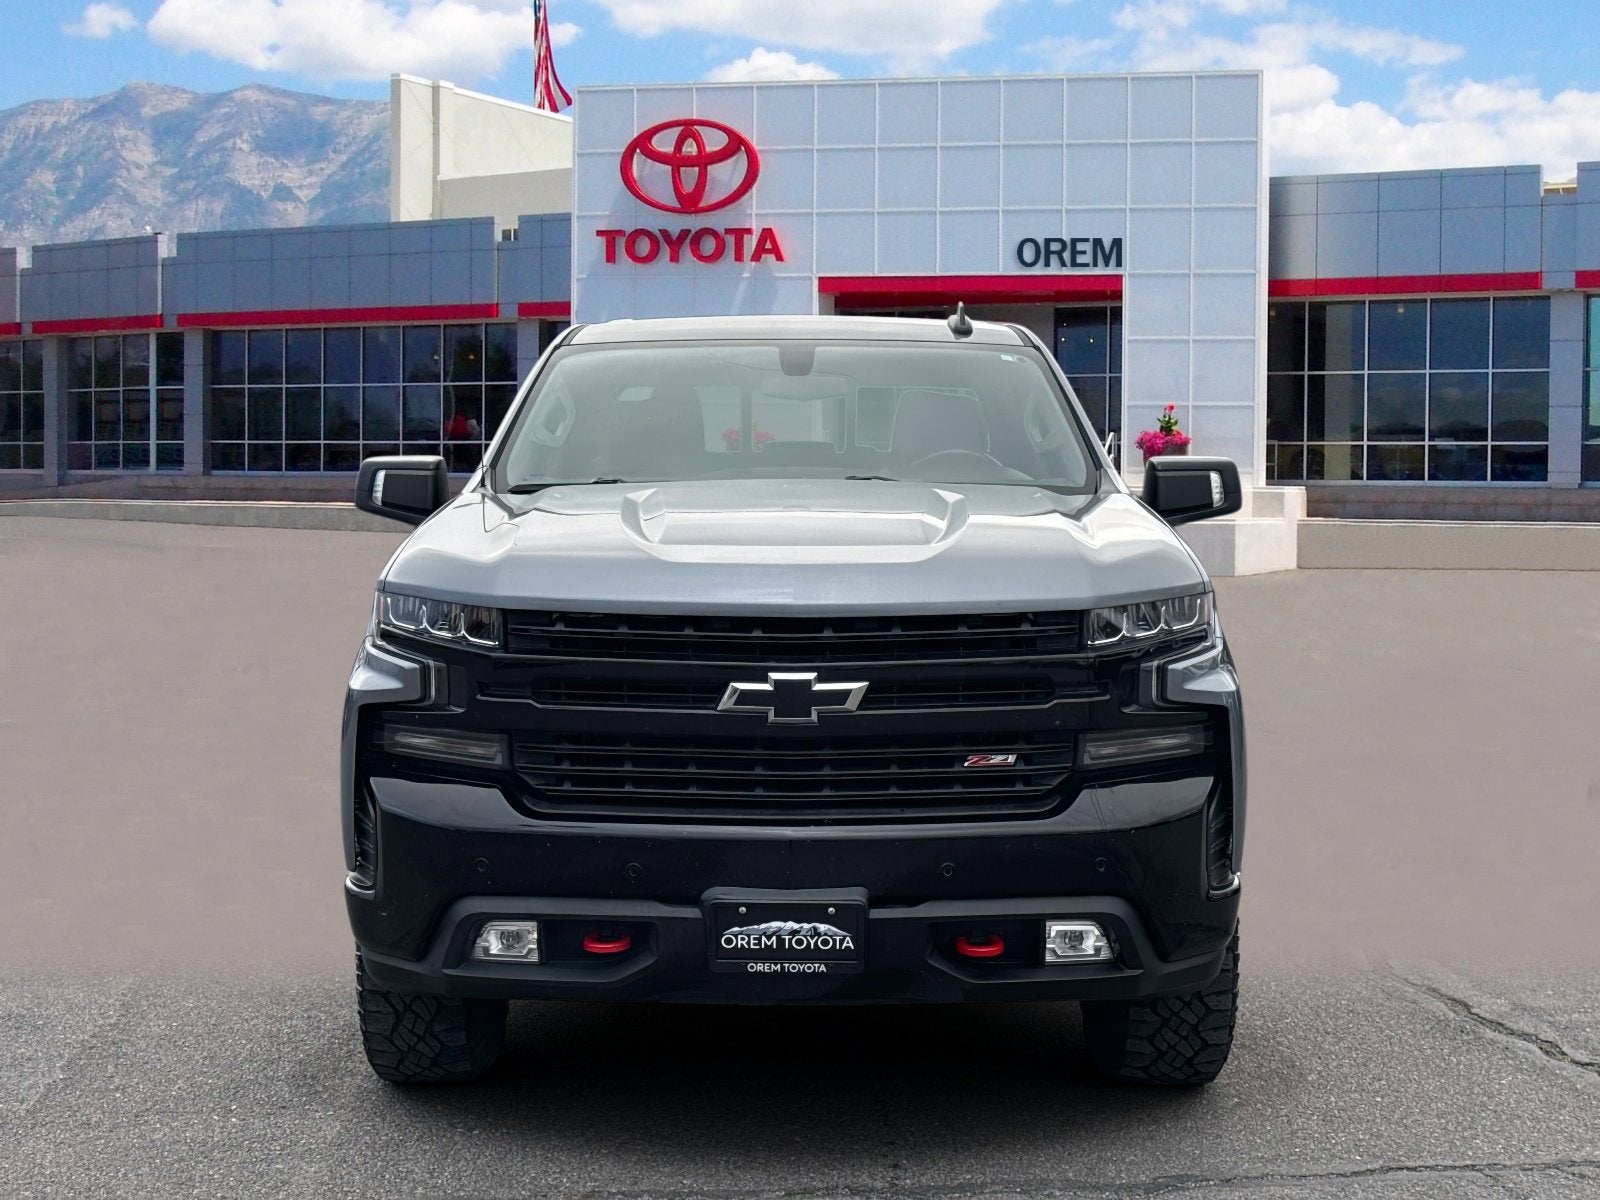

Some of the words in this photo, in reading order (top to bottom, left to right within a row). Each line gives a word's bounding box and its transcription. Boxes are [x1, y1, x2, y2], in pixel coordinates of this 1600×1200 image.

[596, 227, 785, 264] TOYOTA
[1016, 237, 1123, 268] OREM
[963, 753, 1018, 768] Z71
[721, 934, 777, 949] OREM
[781, 935, 855, 950] TOYOTA
[747, 963, 781, 973] OREM
[783, 963, 827, 973] TOYOTA
